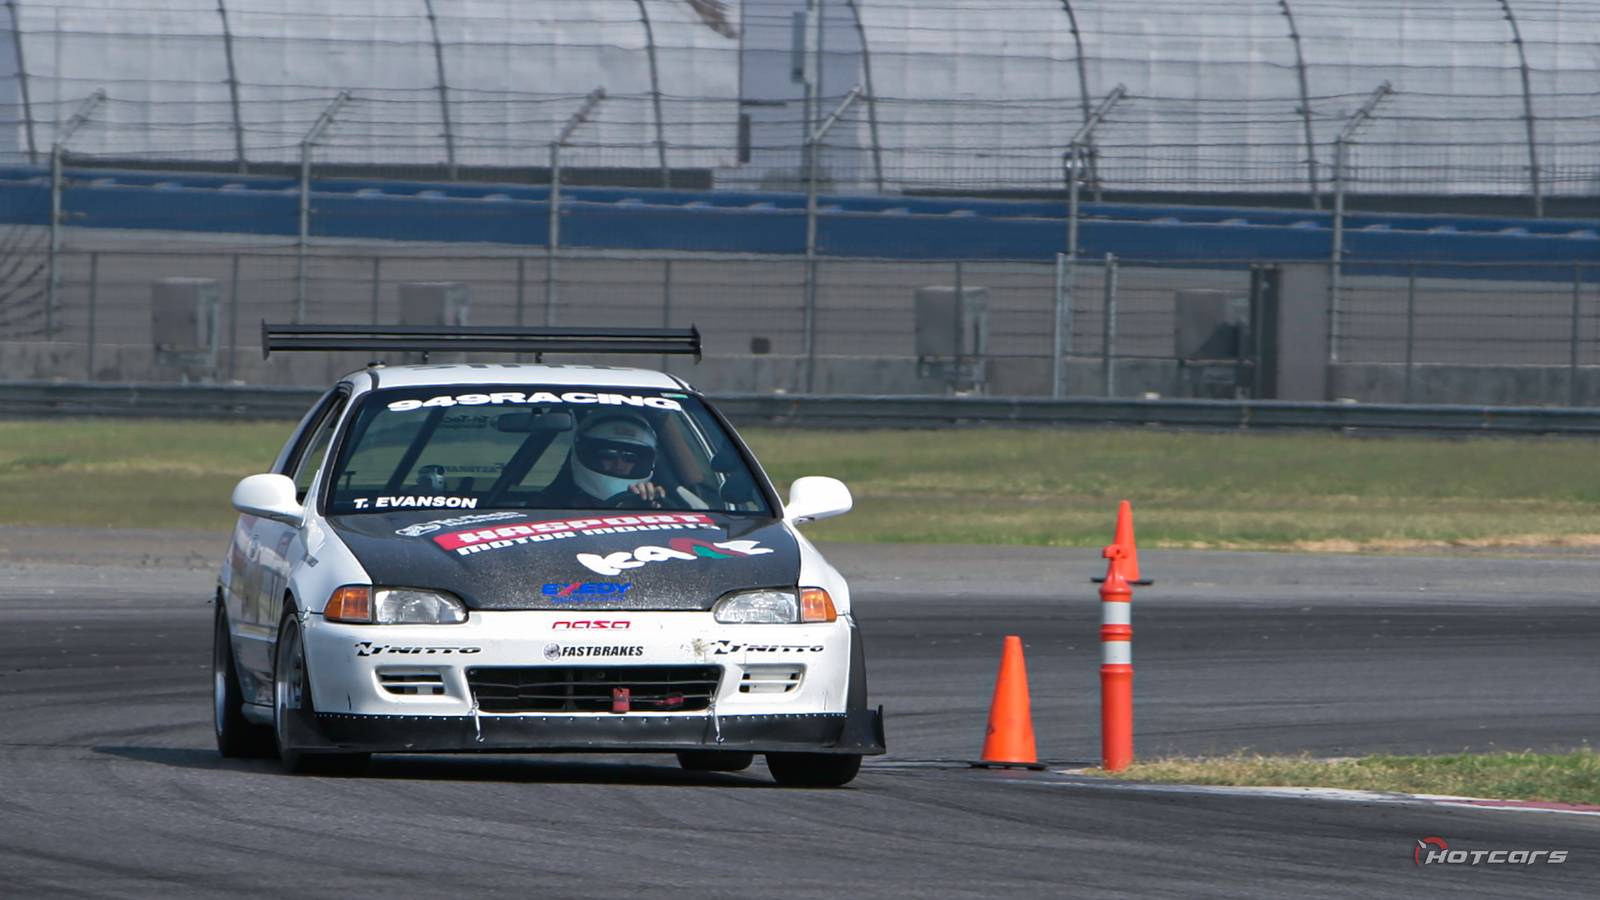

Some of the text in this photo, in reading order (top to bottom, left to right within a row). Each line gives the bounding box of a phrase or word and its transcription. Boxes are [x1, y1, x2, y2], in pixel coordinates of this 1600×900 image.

[387, 392, 682, 412] 949RACING
[354, 496, 477, 509] T. EVANSON
[457, 514, 706, 543] HASPORT
[456, 530, 577, 556] MOTOR
[542, 581, 632, 597] EXEDY
[389, 646, 482, 654] NITTO
[562, 645, 644, 657] FASTBRAKES
[743, 644, 825, 653] NITTO
